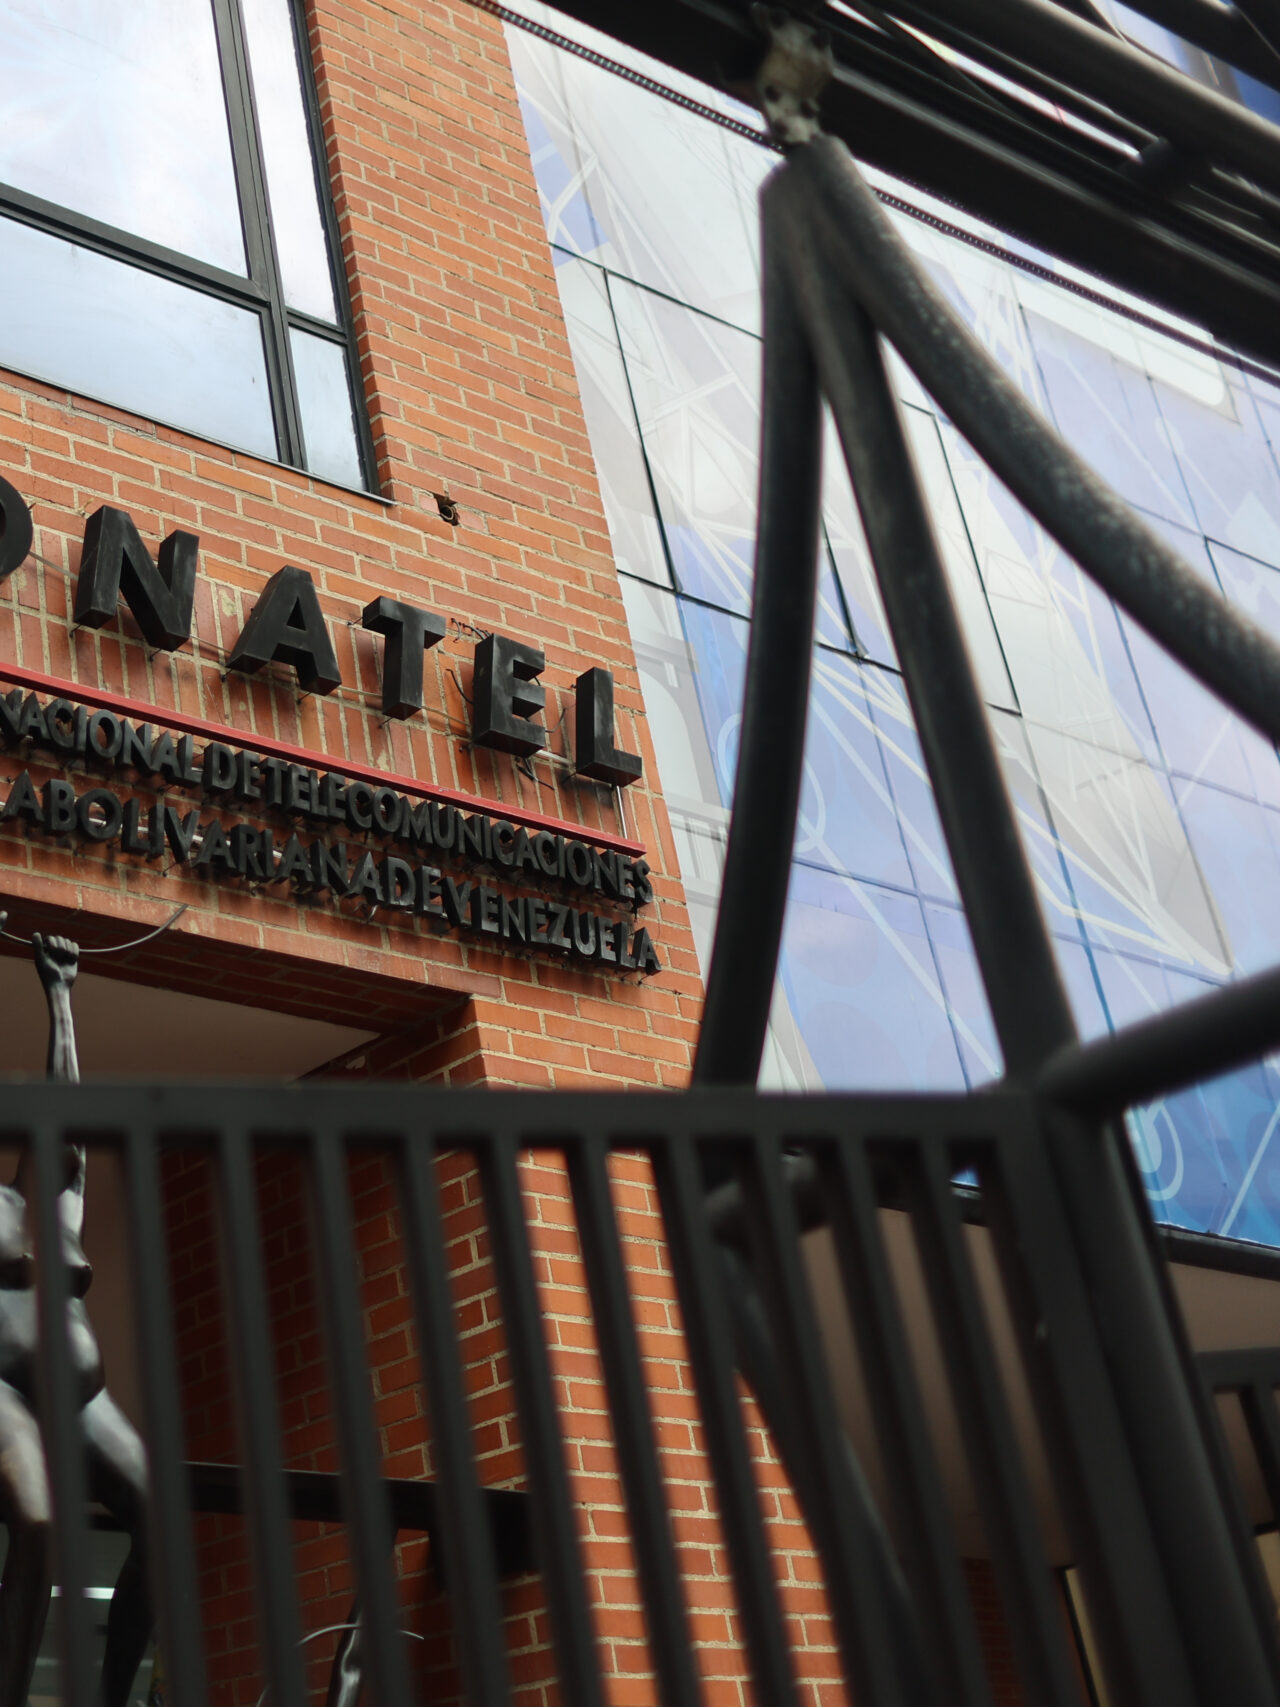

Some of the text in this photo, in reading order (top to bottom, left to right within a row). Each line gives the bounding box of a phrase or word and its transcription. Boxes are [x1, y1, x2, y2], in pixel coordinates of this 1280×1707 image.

[40, 778, 384, 902] BOLIVARIANA
[378, 856, 444, 916] DE
[438, 876, 661, 975] VENEZUELA
[203, 741, 261, 800] DE
[259, 757, 653, 907] TELECOMUNICACIONES
